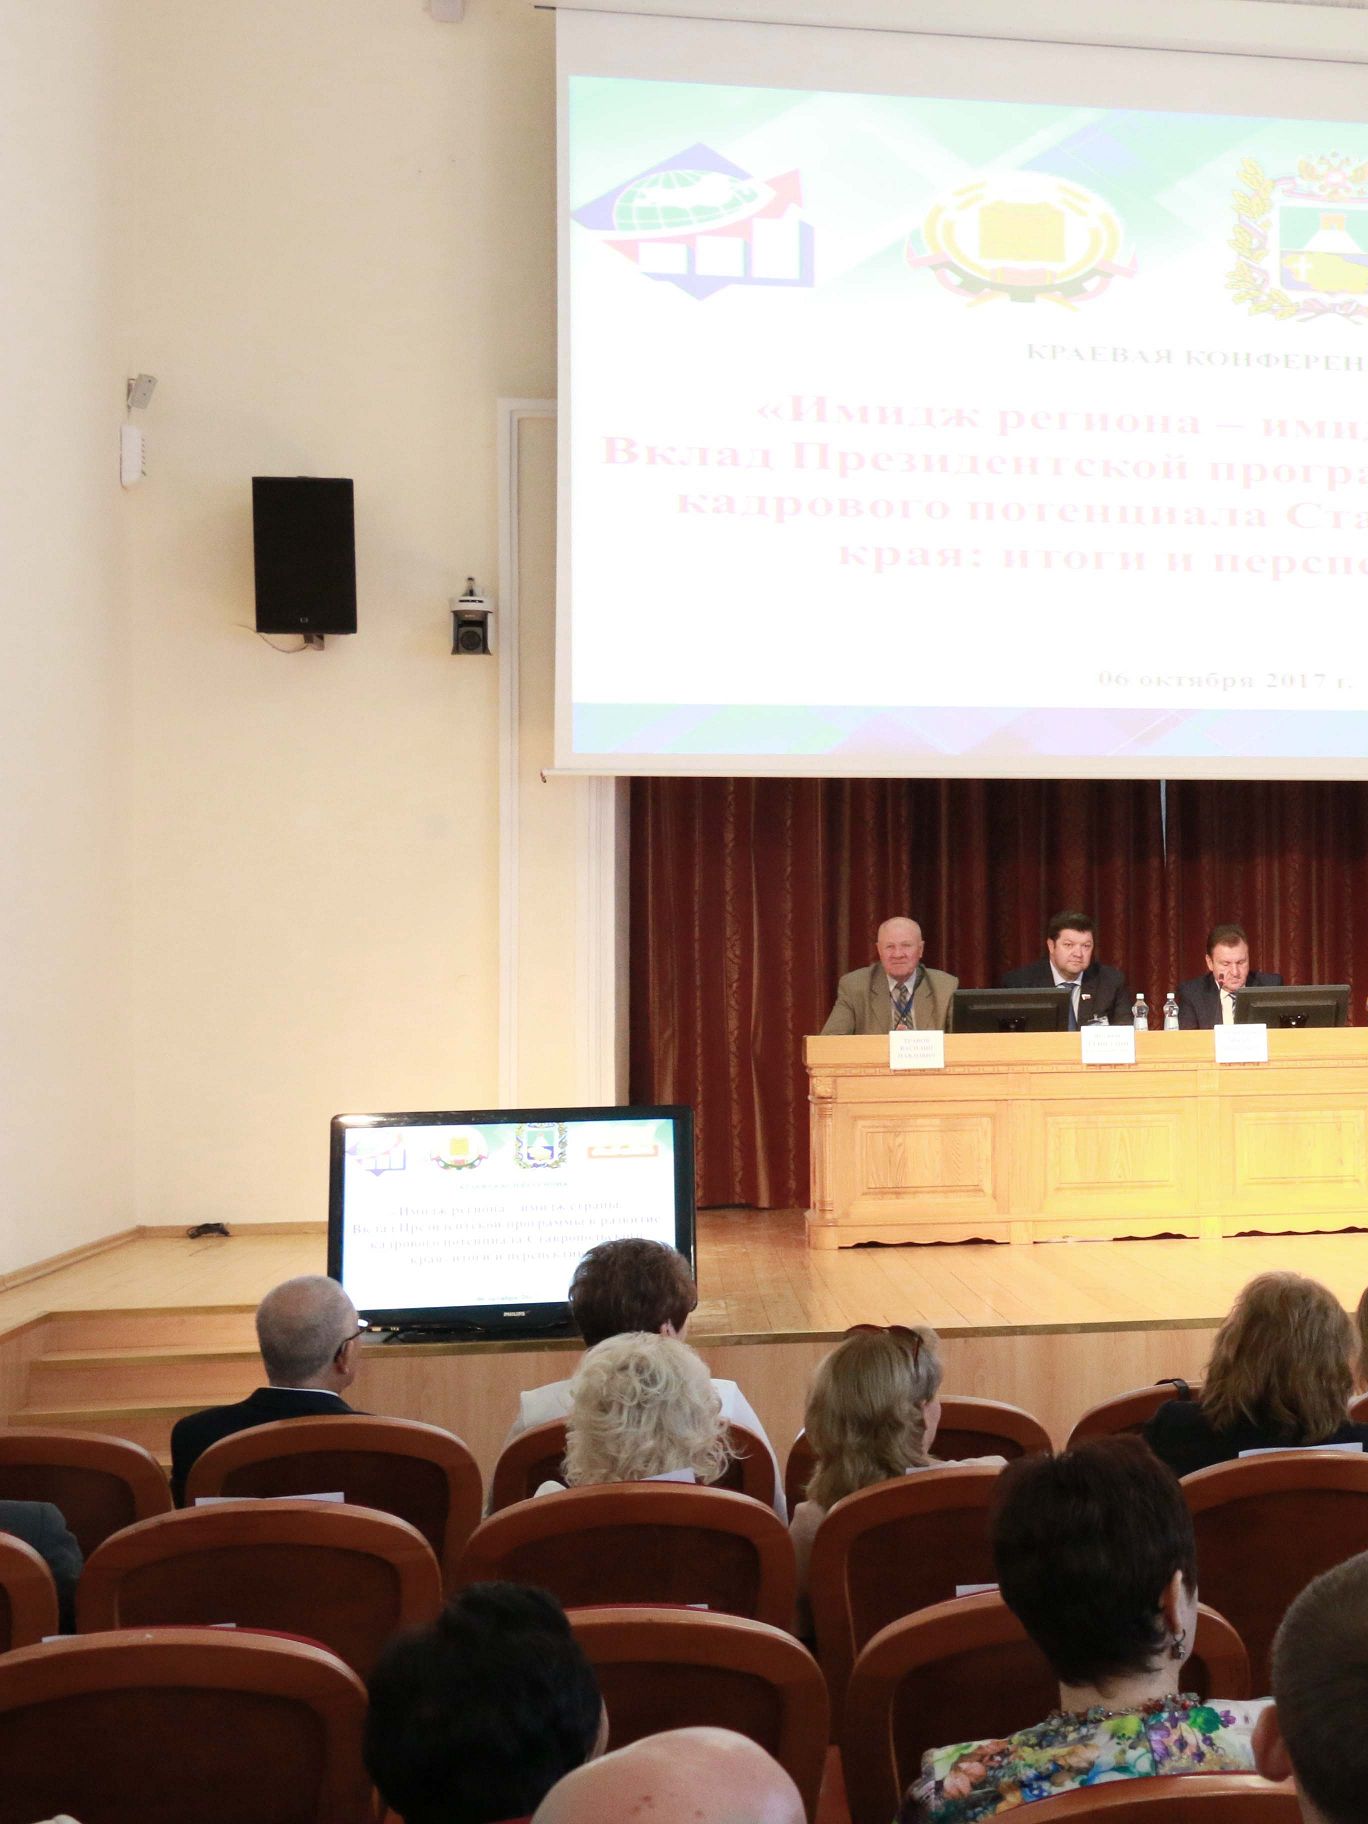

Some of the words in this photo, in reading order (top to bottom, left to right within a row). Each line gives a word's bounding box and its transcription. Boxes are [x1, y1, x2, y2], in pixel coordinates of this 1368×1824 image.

[1026, 343, 1173, 365] КРАЕВАЯ
[755, 394, 982, 429] «Имидж
[998, 407, 1201, 438] региона
[601, 435, 774, 471] Вклад
[792, 442, 1189, 481] Президентской
[676, 494, 950, 524] кадрового
[967, 501, 1266, 529] потенциала
[839, 544, 983, 573] края:
[1002, 547, 1146, 572] итоги
[1166, 551, 1193, 573] и
[1098, 671, 1130, 689] 06
[1138, 672, 1256, 692] октября
[1265, 672, 1326, 689] 2017
